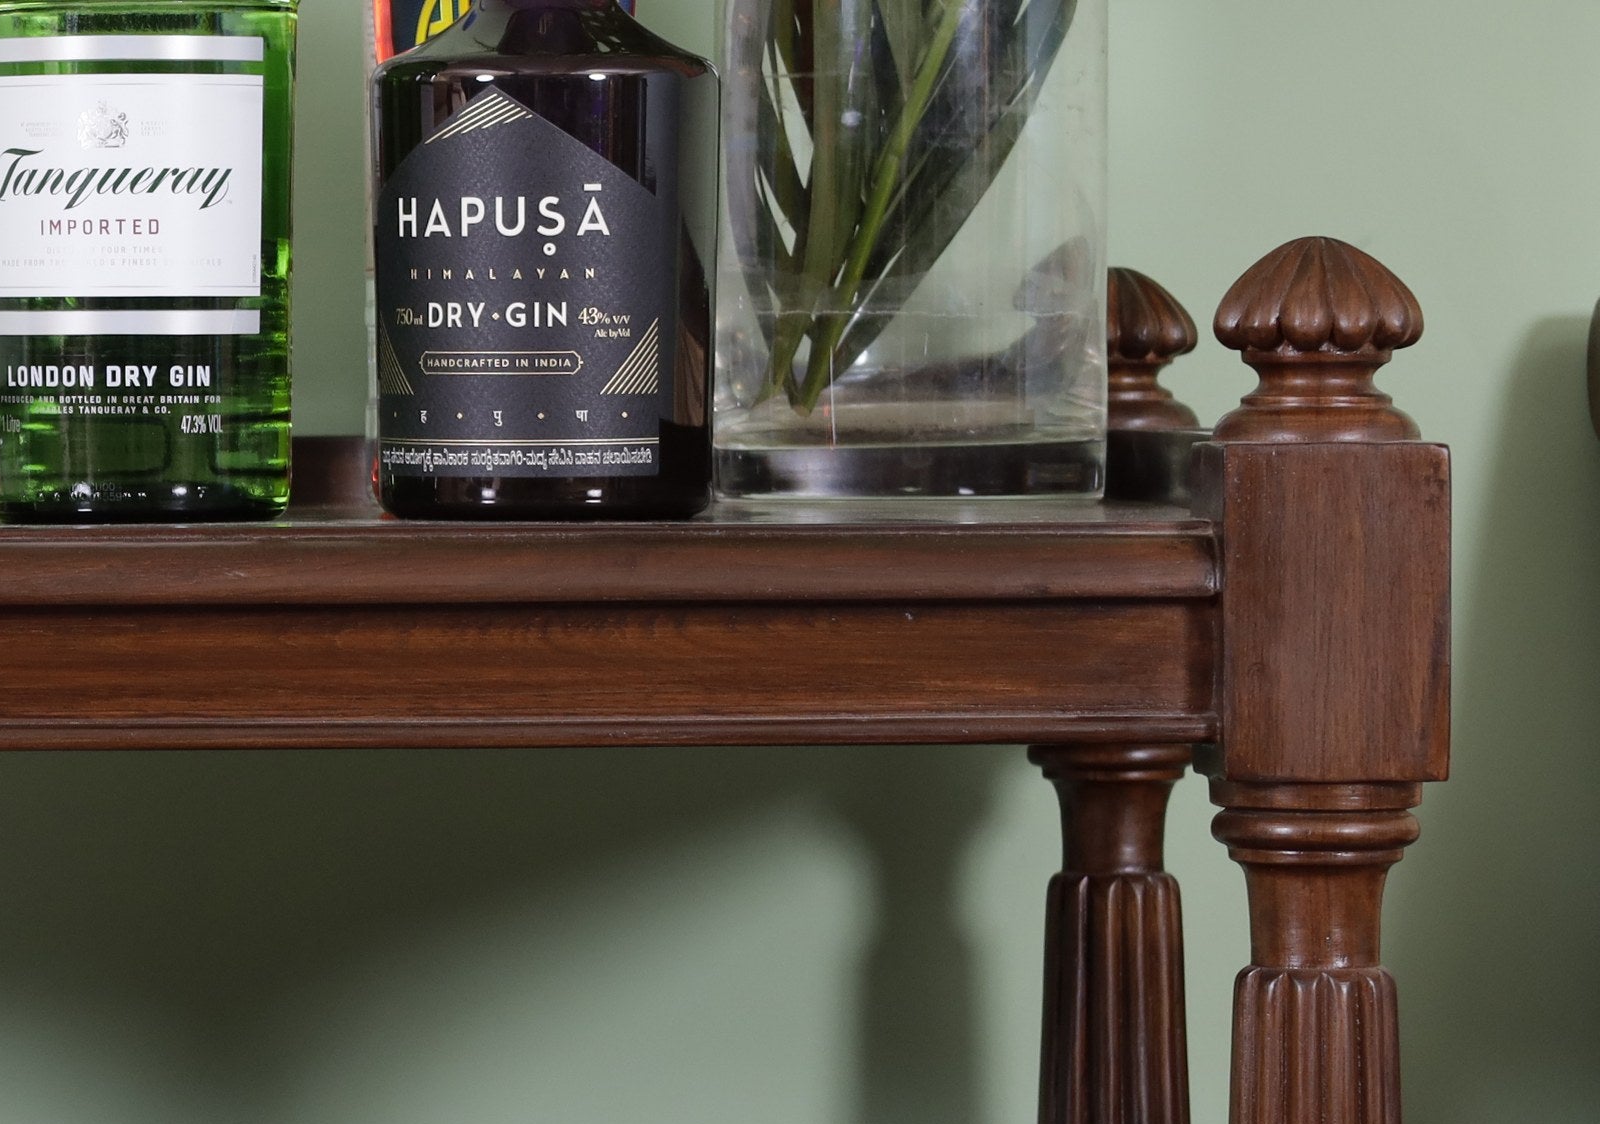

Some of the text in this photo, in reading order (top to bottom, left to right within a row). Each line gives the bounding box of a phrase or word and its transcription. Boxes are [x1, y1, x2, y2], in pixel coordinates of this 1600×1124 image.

[40, 218, 161, 236] IMPORTED
[410, 267, 597, 281] HIMALAYAN
[427, 302, 486, 328] DRY
[505, 301, 568, 328] GIN
[578, 306, 611, 326] 43%
[612, 314, 631, 326] V/V
[426, 358, 572, 369] HANDCRAFTED IN INDIA
[7, 365, 212, 388] LONDON DRY GIN
[38, 395, 56, 404] AND
[59, 395, 103, 404] BOTTLED
[107, 395, 118, 404] IN
[123, 395, 156, 404] GREAT
[160, 395, 200, 404] BRITAIN
[204, 395, 222, 404] FOR
[78, 405, 136, 415] TANQUERAY
[142, 405, 150, 414] &
[154, 405, 172, 414] CO.
[180, 414, 207, 435] 47.3%
